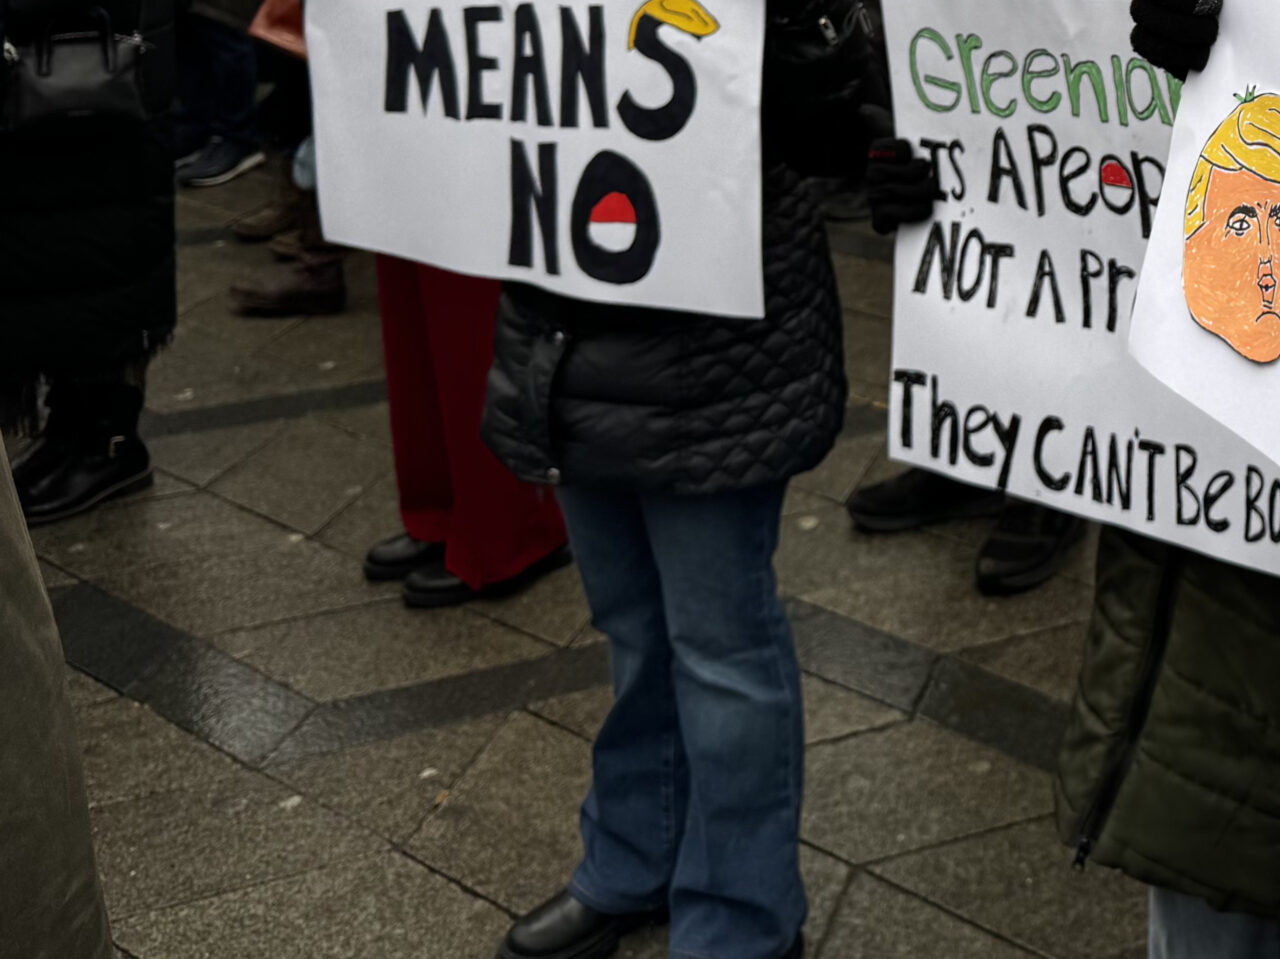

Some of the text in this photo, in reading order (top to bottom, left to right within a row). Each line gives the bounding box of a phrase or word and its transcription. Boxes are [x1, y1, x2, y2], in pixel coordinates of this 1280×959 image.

[508, 138, 662, 285] NO
[920, 138, 967, 203] IS
[912, 221, 1138, 333] NOT A Pr
[894, 368, 1022, 490] They
[1033, 415, 1166, 522] CAN'T
[1174, 443, 1236, 533] Be
